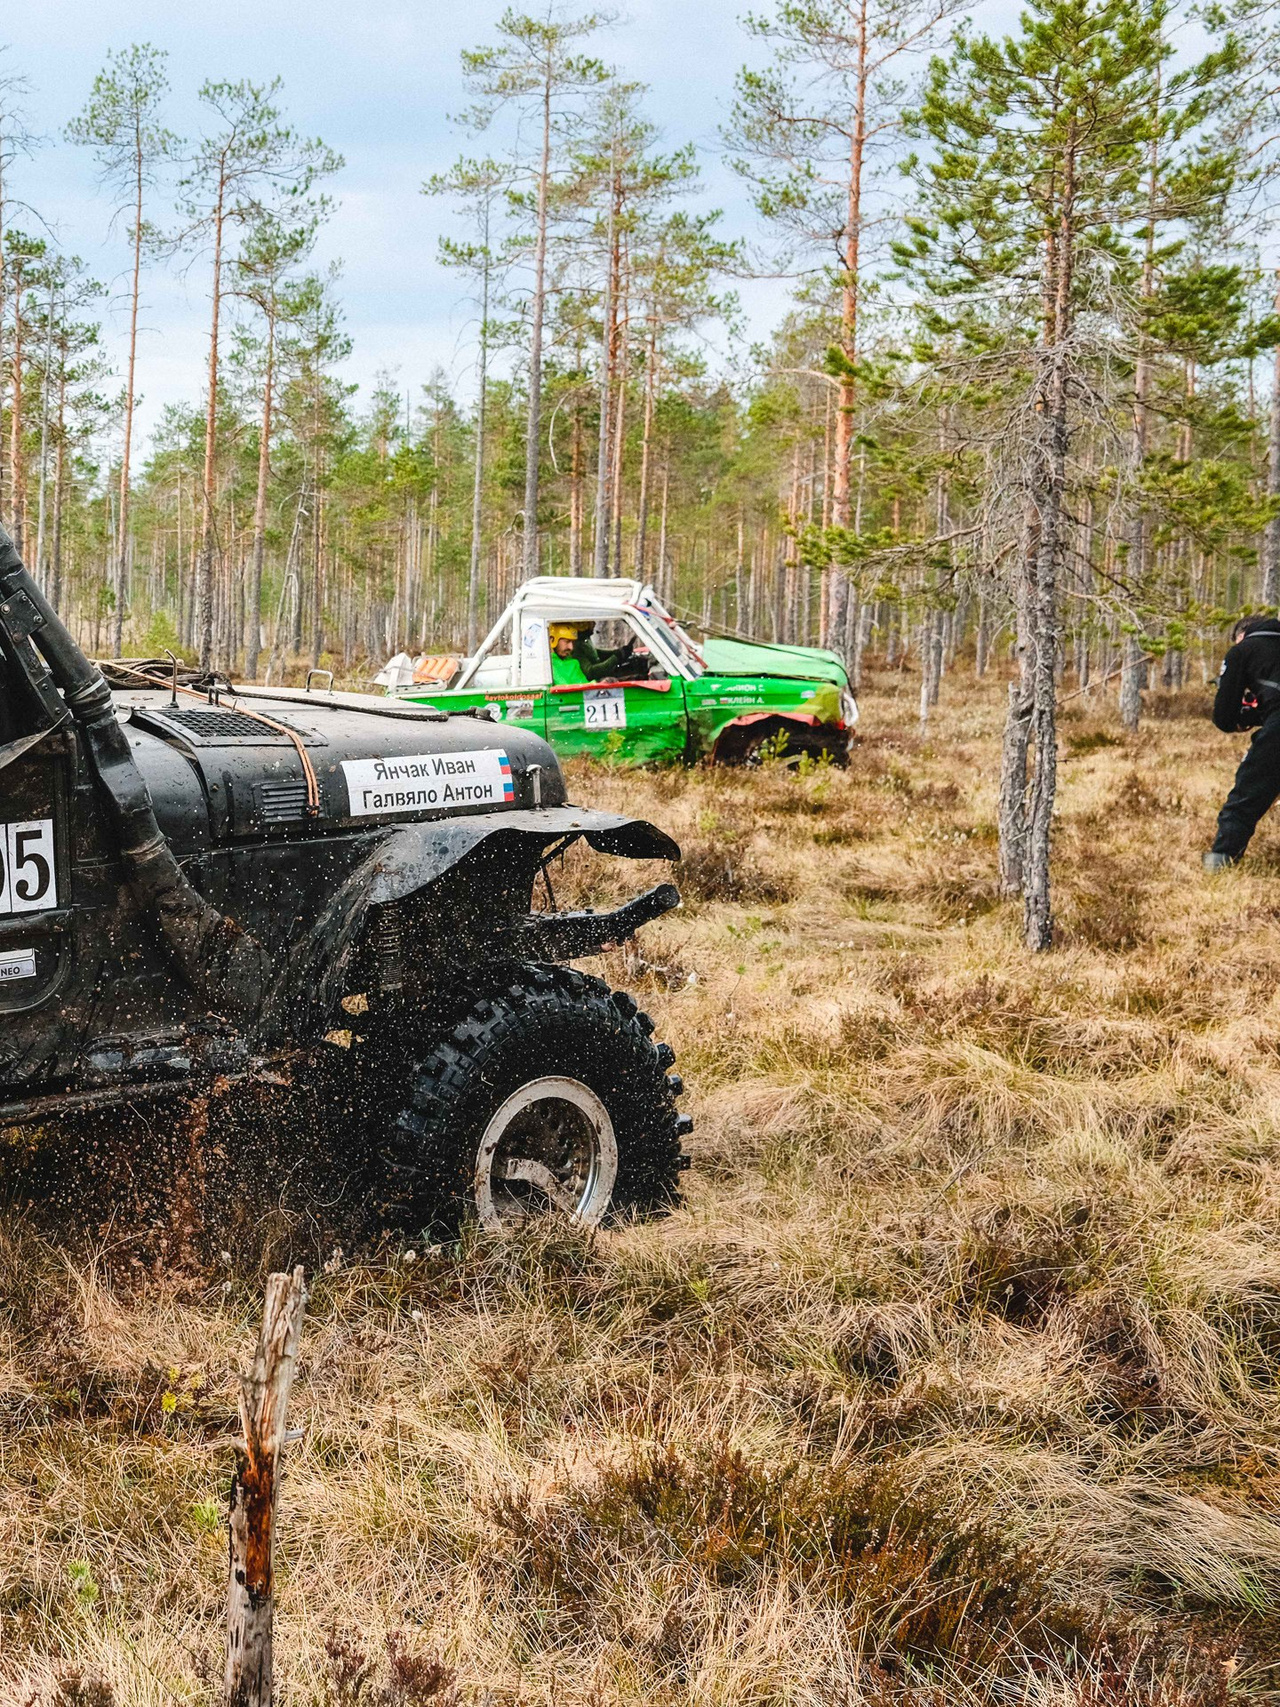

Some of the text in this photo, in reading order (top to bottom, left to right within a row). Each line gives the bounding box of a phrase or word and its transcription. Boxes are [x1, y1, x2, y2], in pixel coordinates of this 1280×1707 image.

[586, 702, 620, 723] 211
[373, 758, 476, 780] Янчак Иван
[362, 783, 493, 809] Галвяло Антон
[0, 966, 21, 977] NEO
